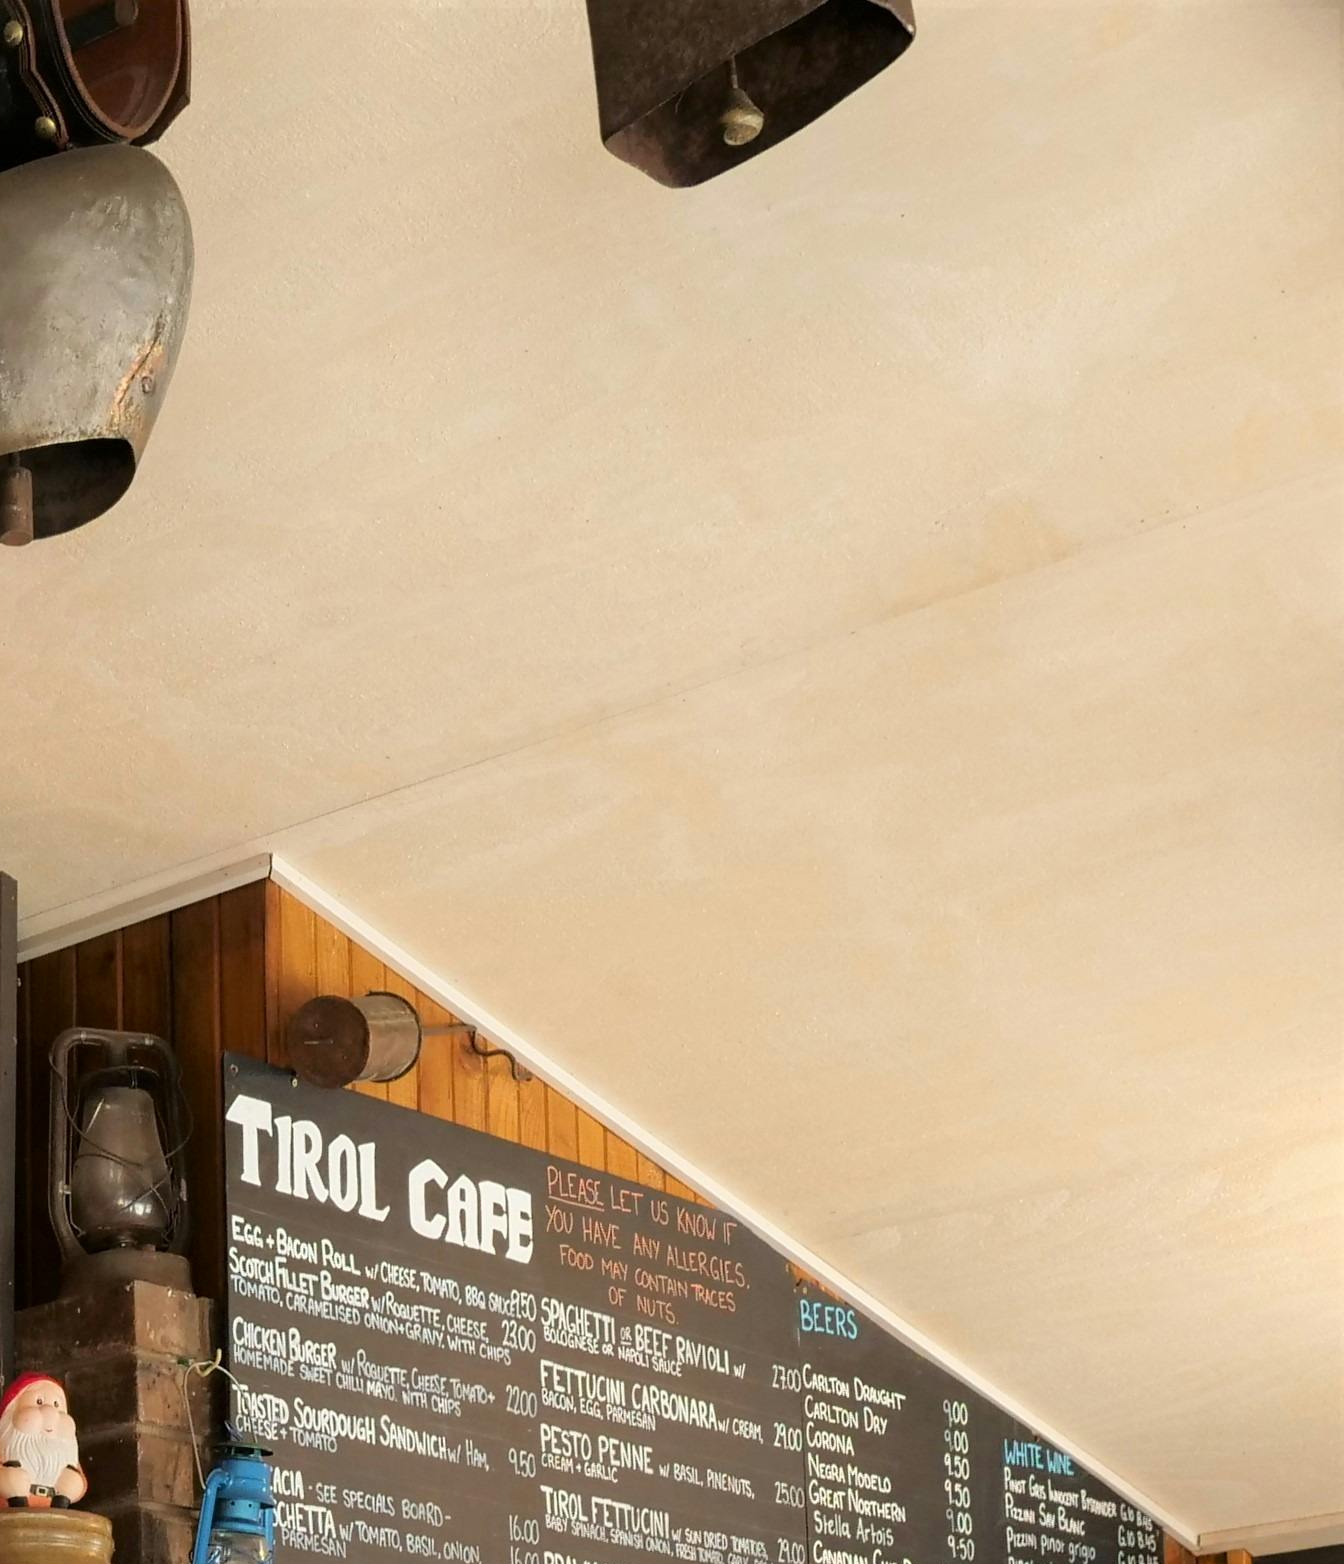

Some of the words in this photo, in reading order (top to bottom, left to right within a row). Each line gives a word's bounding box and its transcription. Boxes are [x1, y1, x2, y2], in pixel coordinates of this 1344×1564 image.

[225, 1094, 390, 1222] TIROL
[409, 1158, 534, 1264] CAFE
[547, 1165, 604, 1208] PLEASE
[610, 1184, 644, 1216] LET
[651, 1199, 669, 1226] US
[677, 1207, 716, 1241] KNOW
[723, 1223, 737, 1246] IF
[231, 1215, 264, 1249] EGG
[276, 1228, 318, 1264] BACON
[321, 1239, 362, 1276] ROLL
[465, 1285, 486, 1307] BBQ
[545, 1205, 573, 1234] YOU
[582, 1217, 622, 1250] HAVE
[633, 1233, 660, 1260] ANY
[667, 1245, 750, 1290] ALLERGIES.
[228, 1246, 275, 1285] SCOTCH
[275, 1256, 319, 1297] FILLET
[320, 1270, 370, 1309] BURGER
[560, 1244, 593, 1271] FOOD
[601, 1258, 628, 1281] MAY
[634, 1268, 688, 1298] CONTAIN
[691, 1284, 736, 1312] TRACES
[608, 1286, 627, 1307] OF
[637, 1295, 679, 1325] NUTS.
[799, 1299, 858, 1340] BEERS
[232, 1316, 287, 1358] CHICKEN
[288, 1327, 337, 1369] BURGER
[540, 1297, 616, 1345] SPAGHETTI
[634, 1323, 672, 1359] BEEF
[676, 1336, 730, 1376] RAVIOLI
[540, 1359, 626, 1407] FETTUCINI
[631, 1383, 718, 1432] CARBONARA
[802, 1363, 850, 1399] CARLTON
[853, 1376, 907, 1411] DRAUGHT
[235, 1415, 279, 1441] CHEESE
[289, 1426, 338, 1453] TOMATO
[293, 1397, 376, 1445] SOURDOUGH
[380, 1414, 446, 1459] SANDWICH
[508, 1447, 537, 1478] 9.50
[804, 1394, 859, 1430] CARLTON
[863, 1405, 888, 1436] DRY
[806, 1421, 855, 1456] CORONA
[540, 1423, 592, 1460] PESTO
[597, 1435, 654, 1475] PENNE
[807, 1452, 846, 1483] NEGRA
[847, 1464, 892, 1494] MODELO
[1004, 1438, 1044, 1470] WHITE
[1046, 1449, 1075, 1476] WINE
[315, 1482, 338, 1504] SEE
[342, 1489, 396, 1516] SPECIALS
[508, 1514, 540, 1545] 16.00
[540, 1485, 588, 1521] TIROL
[592, 1496, 670, 1539] FETTUCINI
[809, 1479, 847, 1511] GREAT
[847, 1488, 906, 1523] NORTHERN
[281, 1528, 347, 1559] PARMESAN
[355, 1521, 403, 1552] TOMATO,
[406, 1533, 442, 1560] BASIL,
[814, 1510, 852, 1539] Stella
[856, 1517, 894, 1547] Artois
